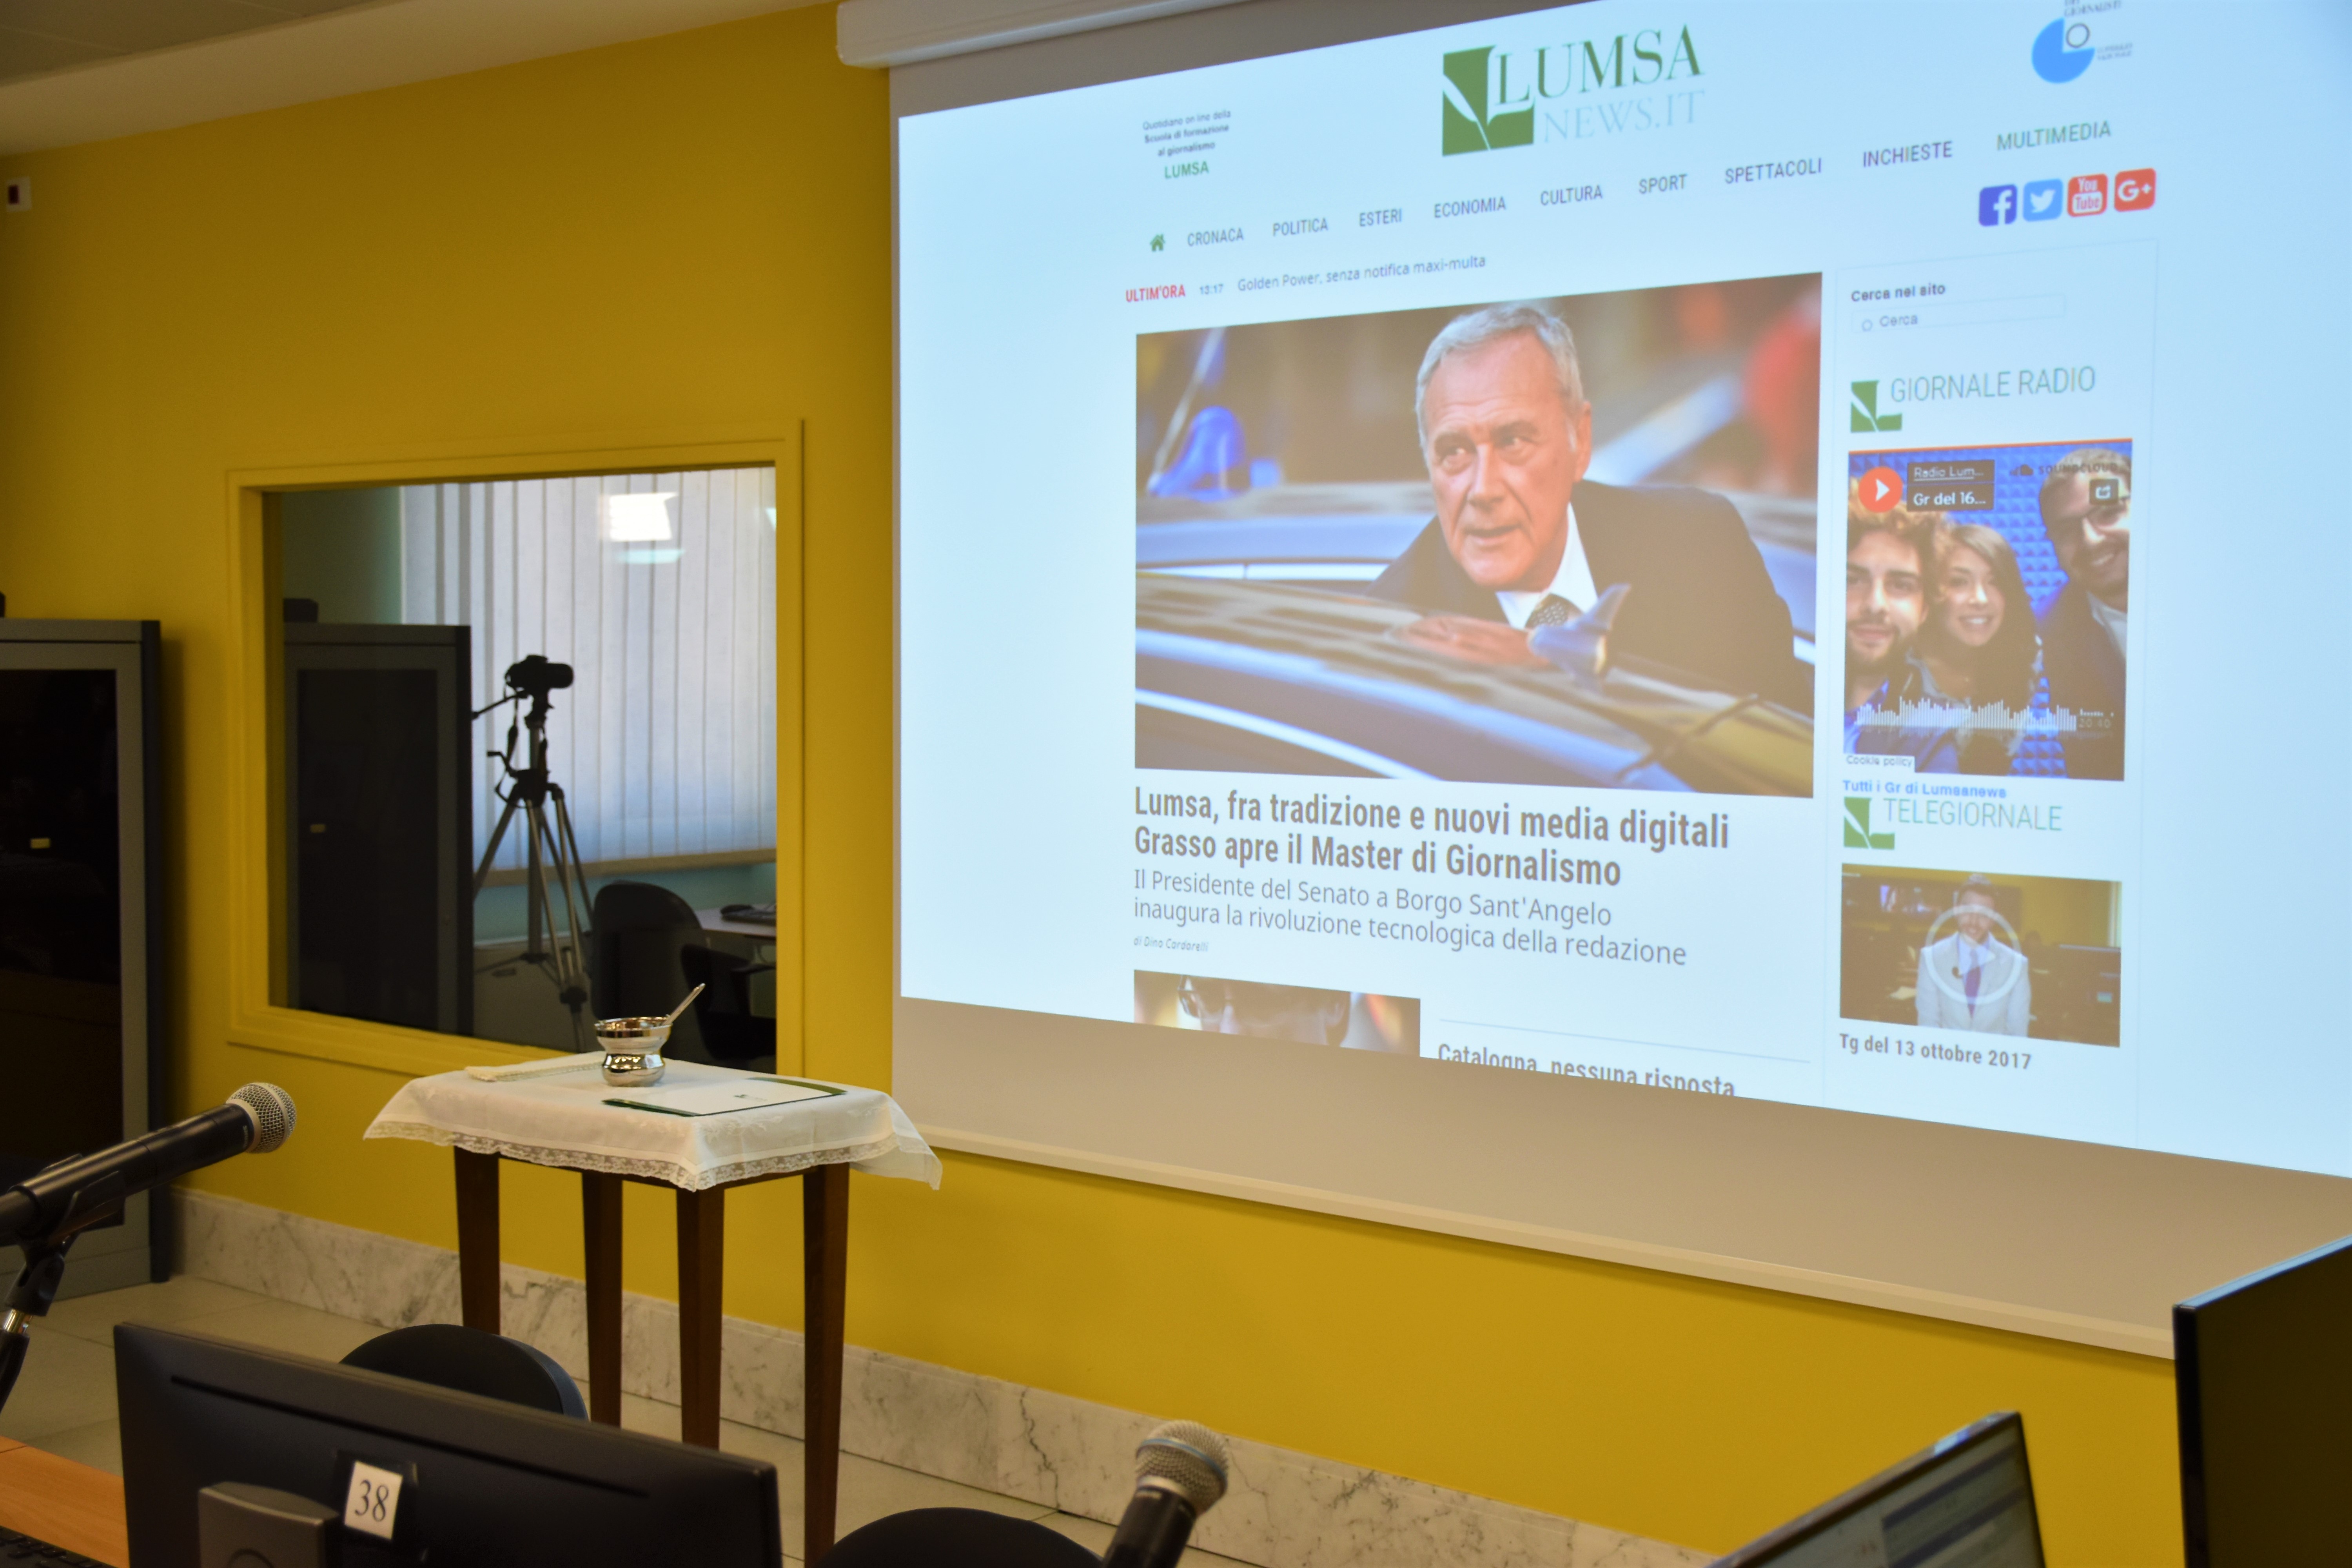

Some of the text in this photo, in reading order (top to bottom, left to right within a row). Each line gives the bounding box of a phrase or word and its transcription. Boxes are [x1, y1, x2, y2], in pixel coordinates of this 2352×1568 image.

[1495, 24, 1705, 105] LUMSA
[1143, 118, 1183, 130] Quotidiano
[1213, 110, 1231, 120] della
[1543, 90, 1705, 143] NEWS.IT
[1145, 125, 1229, 143] Scuola di formazione
[1158, 142, 1215, 156] al giornalismo
[1164, 161, 1209, 179] LUMSA
[1187, 120, 2111, 247] CRONACA POLITICA ESTERI ECONOMIA CULTURA SPORT SPETTACOLI INCHIESTE MULTIMEDIA
[2078, 178, 2098, 192] You
[2118, 179, 2152, 202] G+
[2076, 196, 2100, 210] Tube
[1238, 255, 1486, 292] Golden Power, senza notifica maxi-multa
[1125, 283, 1223, 302] ULTIM'ORA 13:17
[1851, 283, 1946, 302] Cerca nel sito
[1879, 314, 1918, 327] Cerca
[1891, 365, 2096, 403] GIORNALE RADIO
[1914, 466, 1945, 478] Radio
[1913, 491, 1986, 506] Gr del 16...
[1846, 755, 1913, 768] Cookie policy
[1843, 780, 1873, 792] Tutti
[1877, 781, 1880, 791] i
[1884, 782, 1900, 793] Gr
[1905, 781, 1918, 794] di
[1135, 786, 1729, 853] Lumsa, fra tradizione e nuovi media digitali
[1883, 798, 2062, 831] TELEGIORNALE
[1135, 825, 1621, 886] Grasso apre il Master di Giornalismo
[1134, 869, 1612, 930] Il Presidente del Senato a Borgo Sant'Angelo
[1134, 898, 1686, 965] inaugura la rivoluzione tecnologica della redazione
[1144, 936, 1163, 948] Dino
[1839, 1033, 2031, 1070] Tg del 13 ottobre 2017
[354, 1479, 389, 1522] 38
